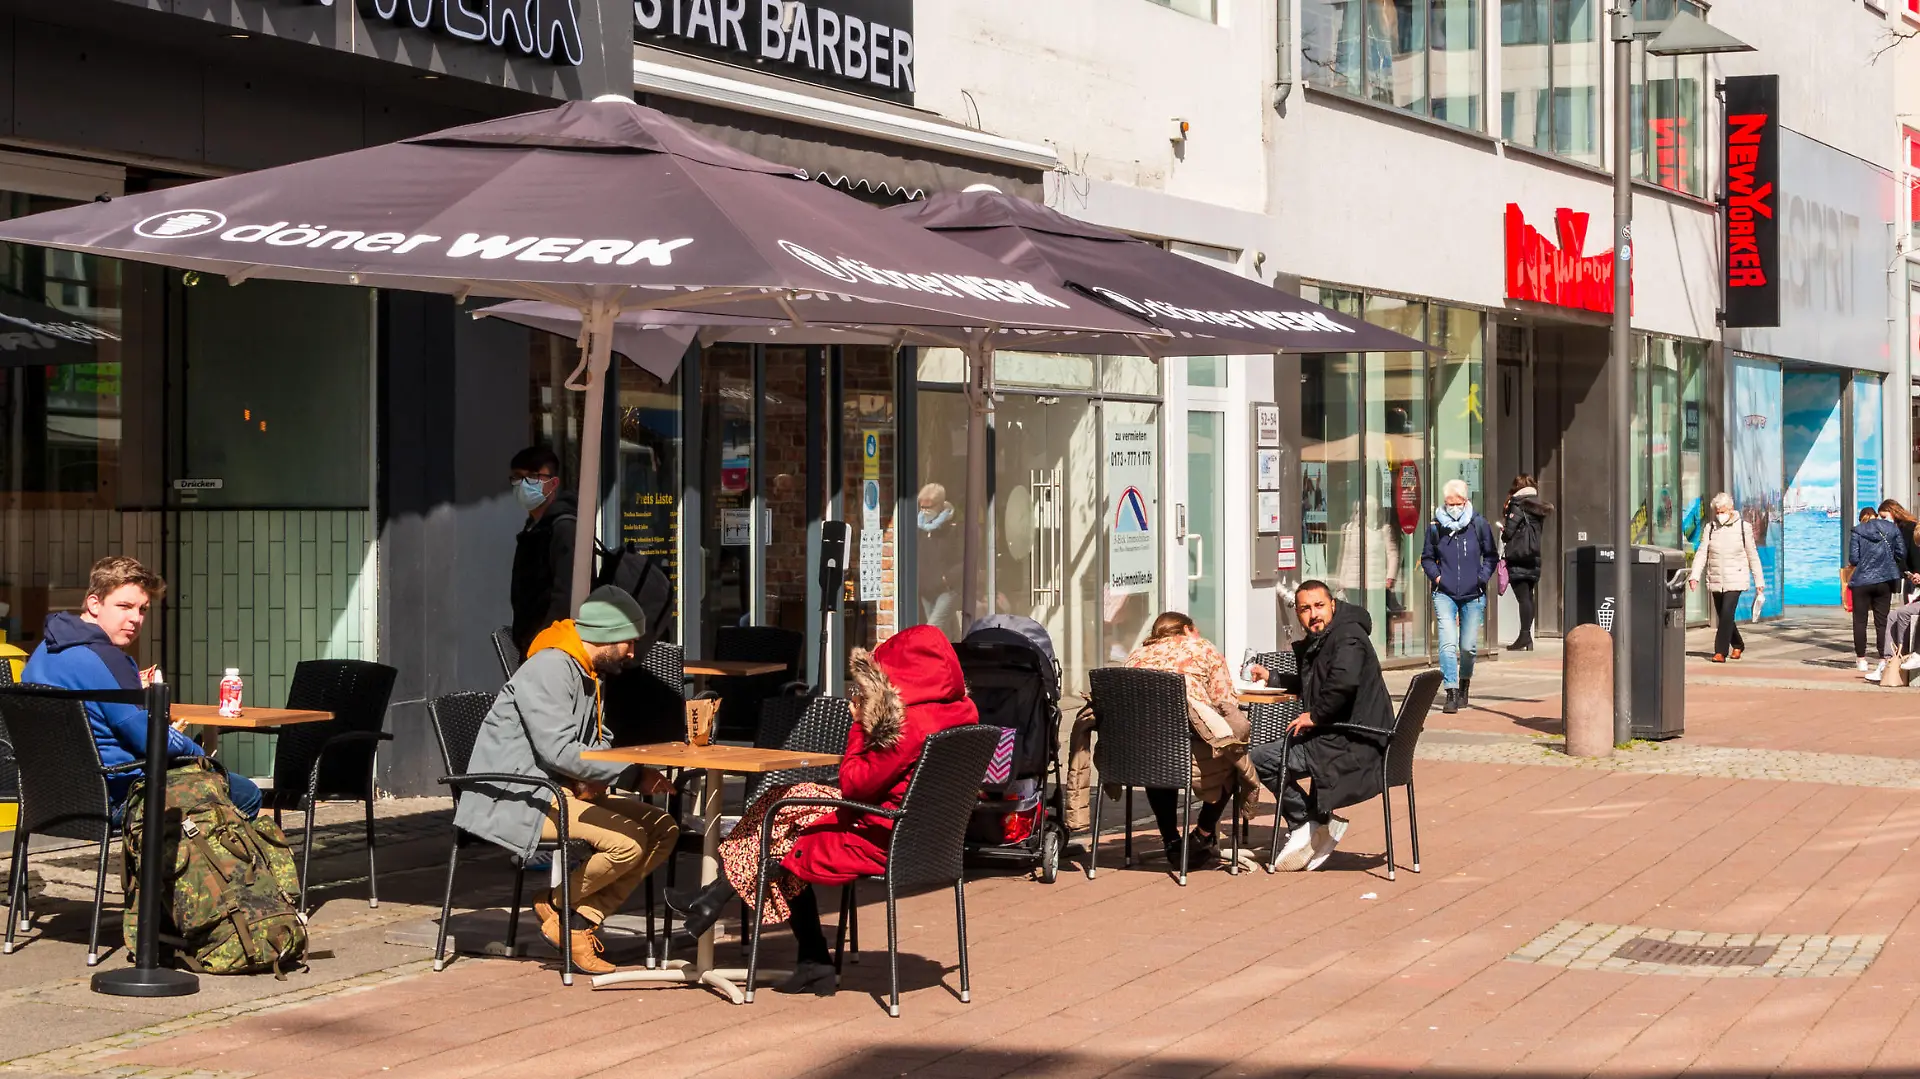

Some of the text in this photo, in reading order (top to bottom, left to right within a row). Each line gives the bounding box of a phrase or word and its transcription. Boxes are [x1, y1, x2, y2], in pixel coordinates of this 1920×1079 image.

[761, 0, 916, 92] BARBER
[219, 220, 695, 267] döner WERK
[1261, 412, 1277, 426] 52-54
[1115, 430, 1147, 441] zu vermieten
[1111, 451, 1123, 467] 0173
[181, 480, 216, 488] Drücken
[635, 492, 673, 505] Preis Liste
